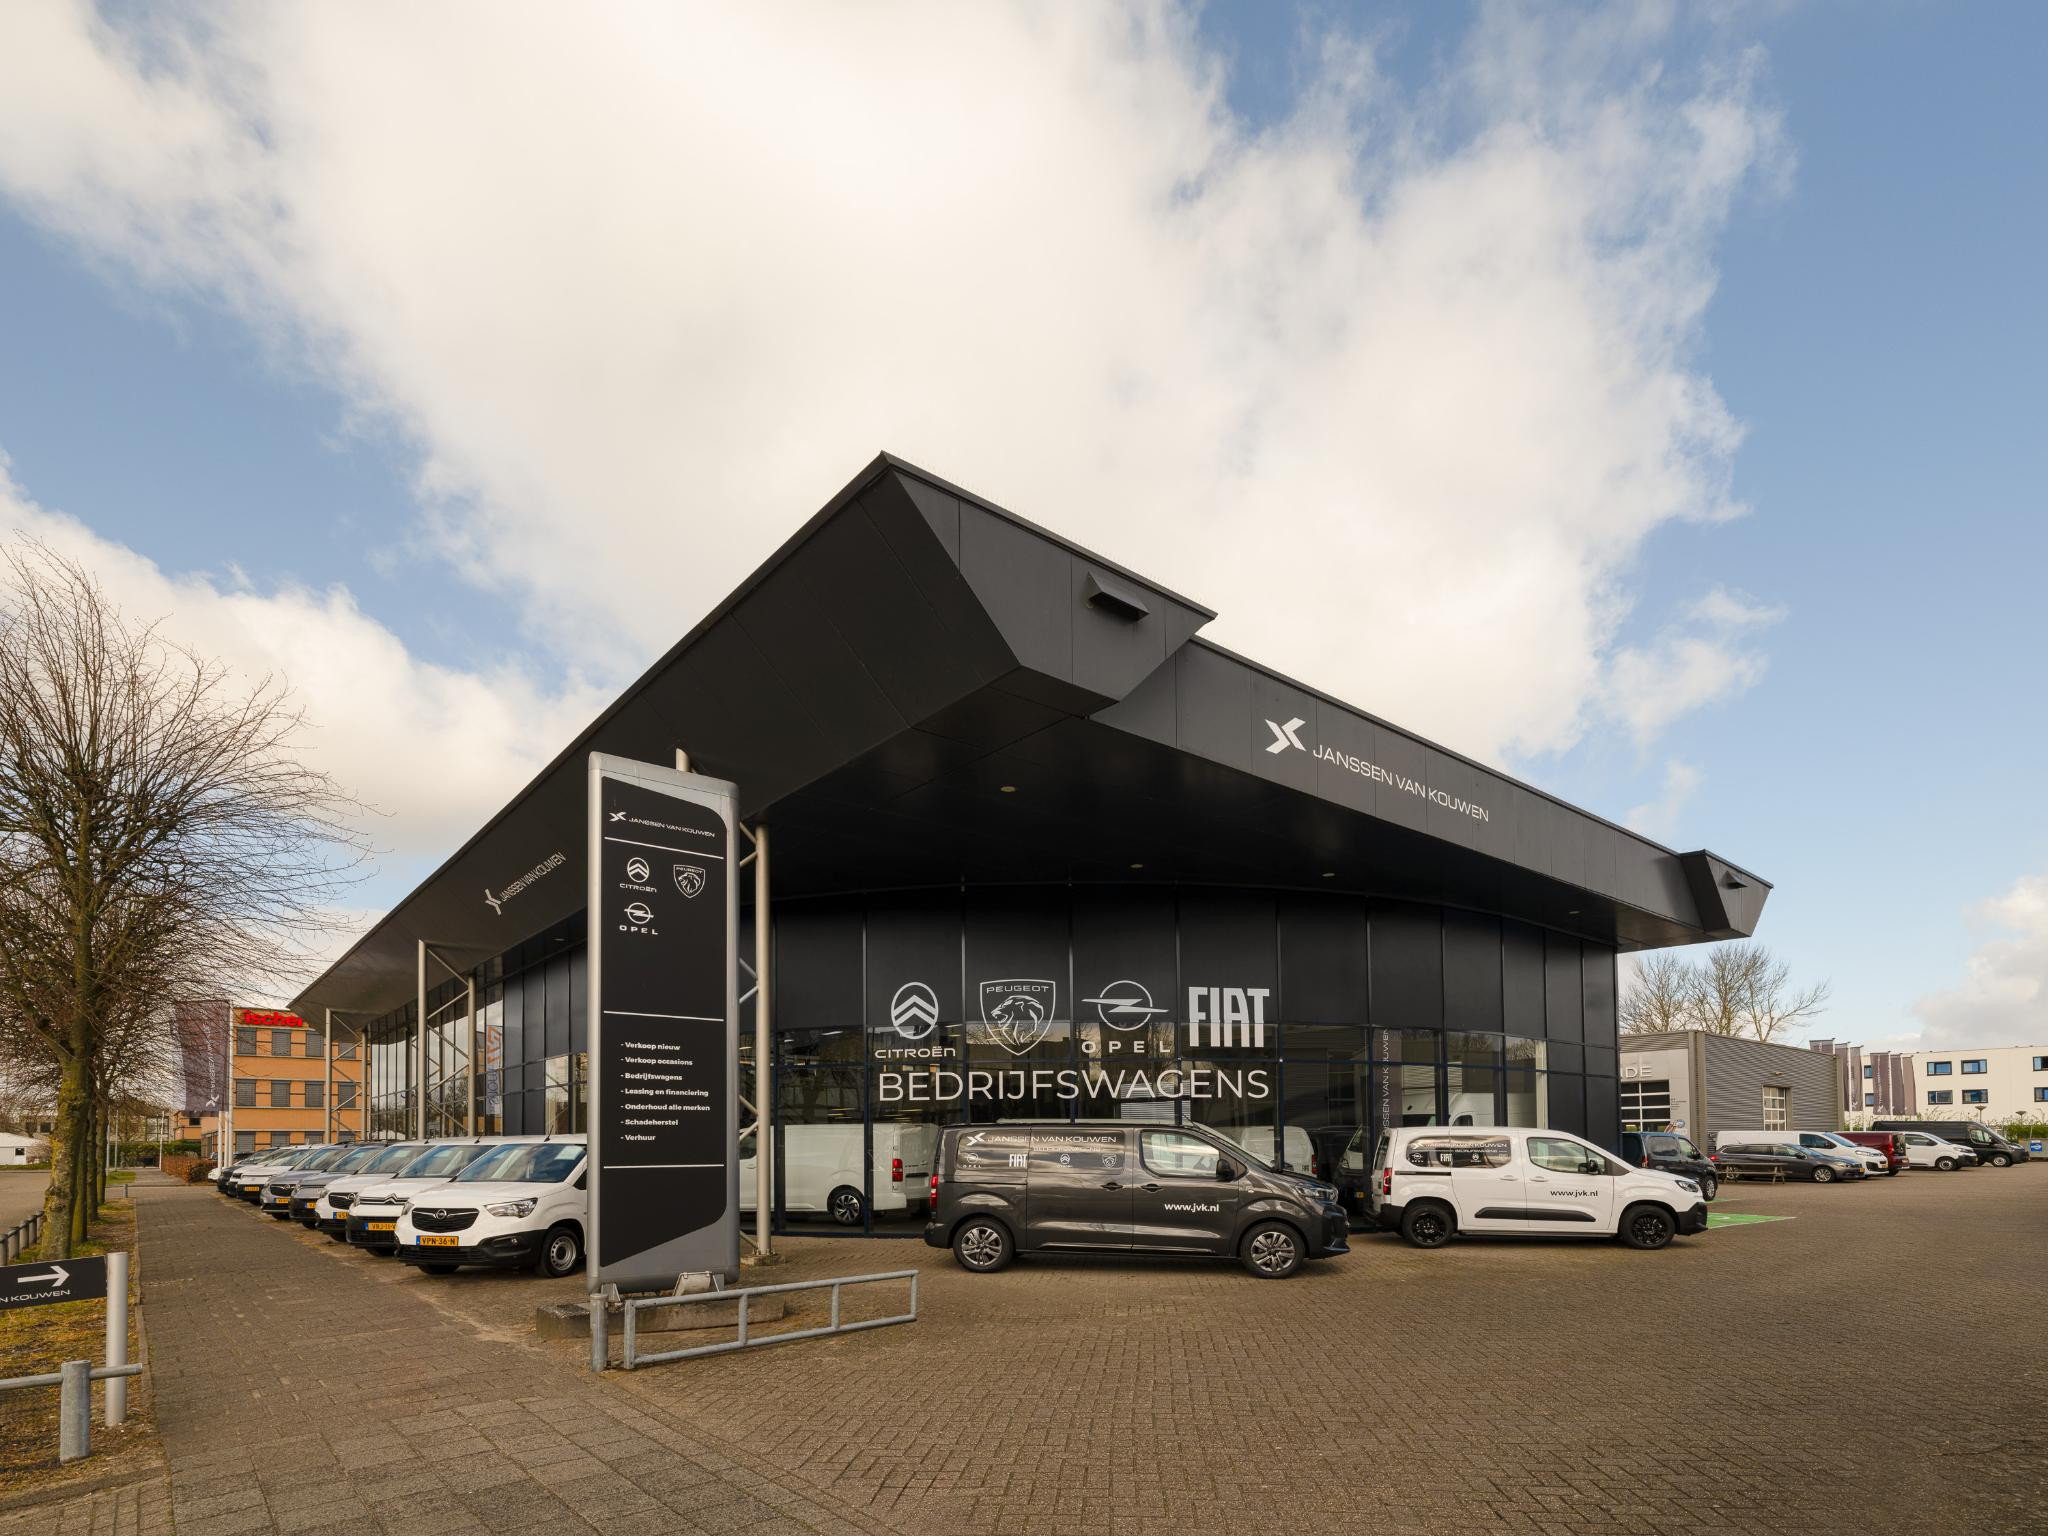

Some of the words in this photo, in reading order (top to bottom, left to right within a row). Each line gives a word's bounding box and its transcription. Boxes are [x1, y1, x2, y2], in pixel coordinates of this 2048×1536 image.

[1313, 745, 1392, 785] JANSSEN
[1395, 774, 1425, 798] VAN
[1428, 790, 1489, 822] KOUWEN
[629, 818, 665, 828] JANSSEN
[500, 880, 526, 901] JANSSEN
[533, 852, 566, 877] KOUWEN
[619, 924, 658, 935] OPEL
[986, 985, 1049, 993] PEUGEOT
[1188, 986, 1270, 1048] FIAT
[625, 1042, 657, 1050] Verkoop
[1081, 1040, 1171, 1053] OPEL
[874, 1046, 956, 1059] CITROËN
[625, 1057, 657, 1065] Verkoop
[625, 1072, 683, 1081] Bedrijfswagens
[879, 1069, 1270, 1102] BEDRIJFSWAGENS
[1382, 1075, 1390, 1097] VAN
[625, 1088, 654, 1096] Leasing
[665, 1088, 709, 1097] financiering
[625, 1103, 668, 1111] Onderhoud
[1009, 1153, 1028, 1168] FIAT
[1550, 1190, 1599, 1198] www.jvk.nl
[1164, 1203, 1220, 1213] www.jvk.nl
[421, 1237, 456, 1245] VPN-36-N
[10, 1290, 71, 1302] KOUWEN
